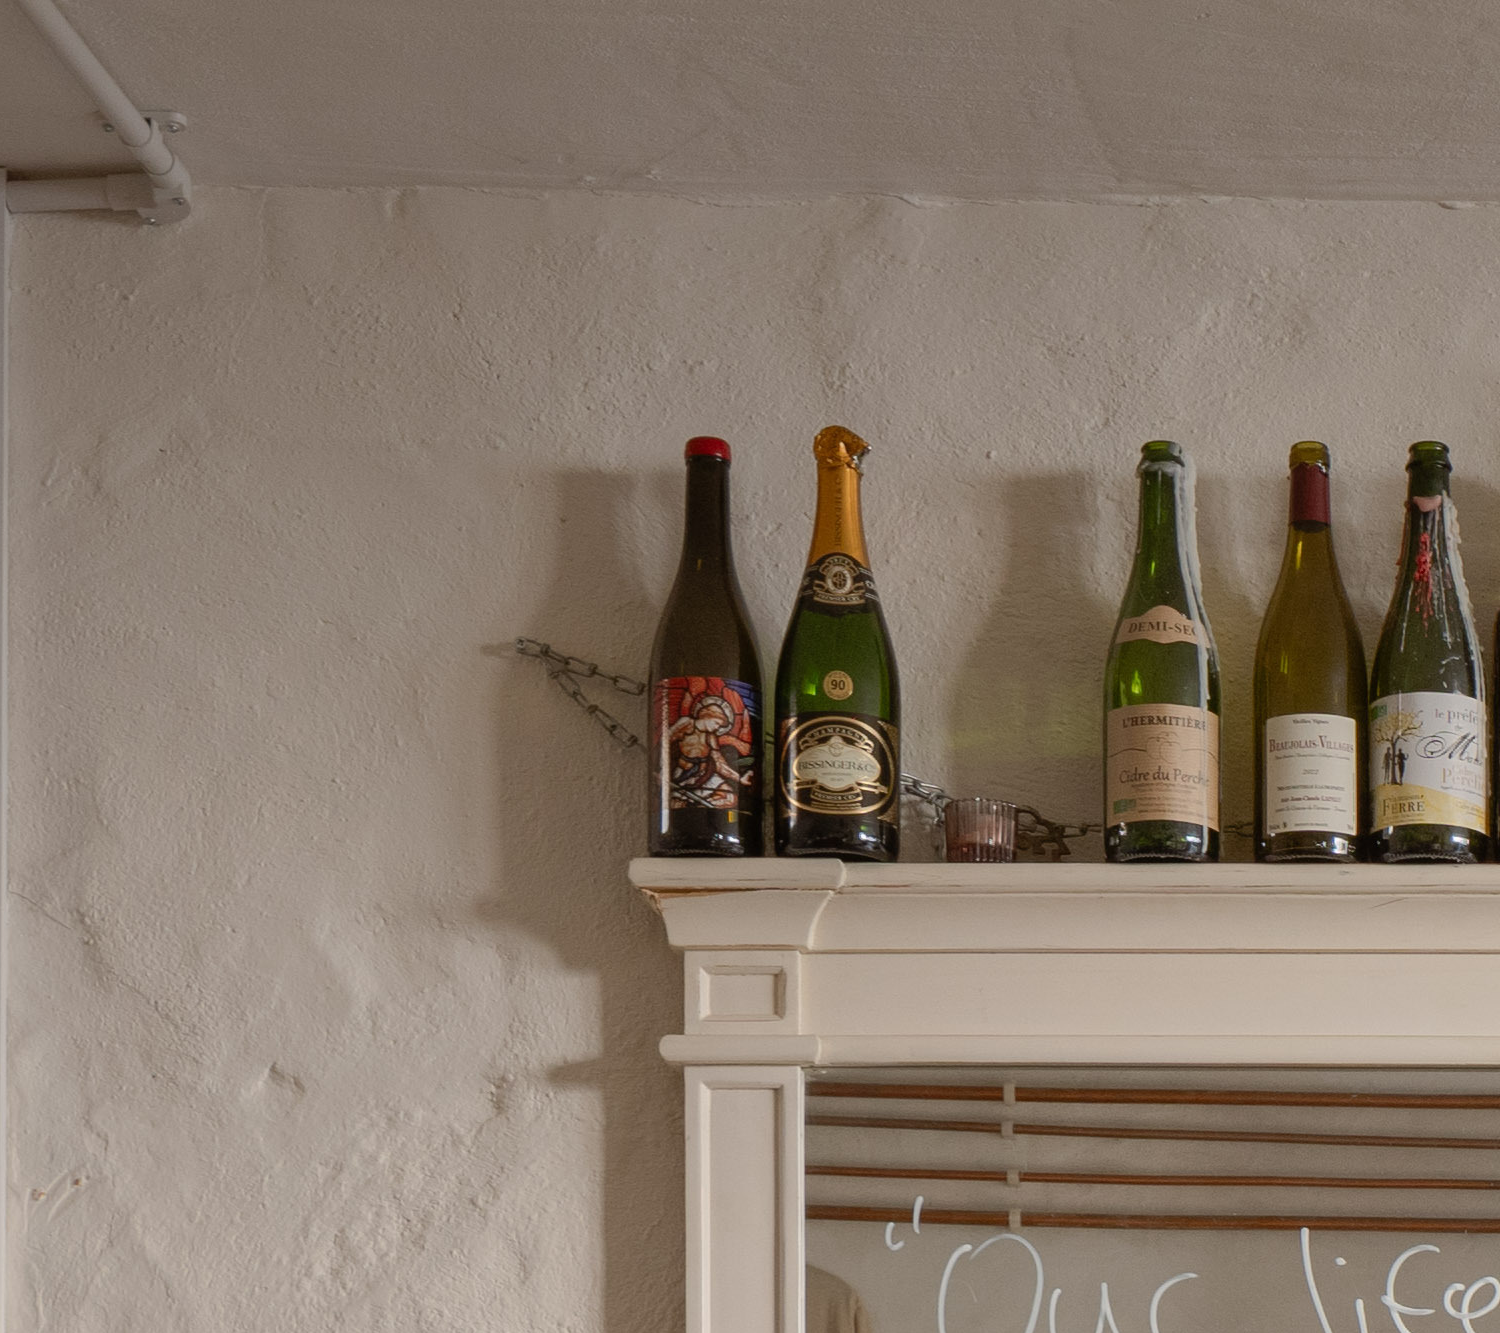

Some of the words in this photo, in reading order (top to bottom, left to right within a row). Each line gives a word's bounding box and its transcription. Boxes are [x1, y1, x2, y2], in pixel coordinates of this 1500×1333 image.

[830, 679, 846, 691] 90
[1120, 765, 1150, 784] Cidre
[1153, 765, 1170, 781] du
